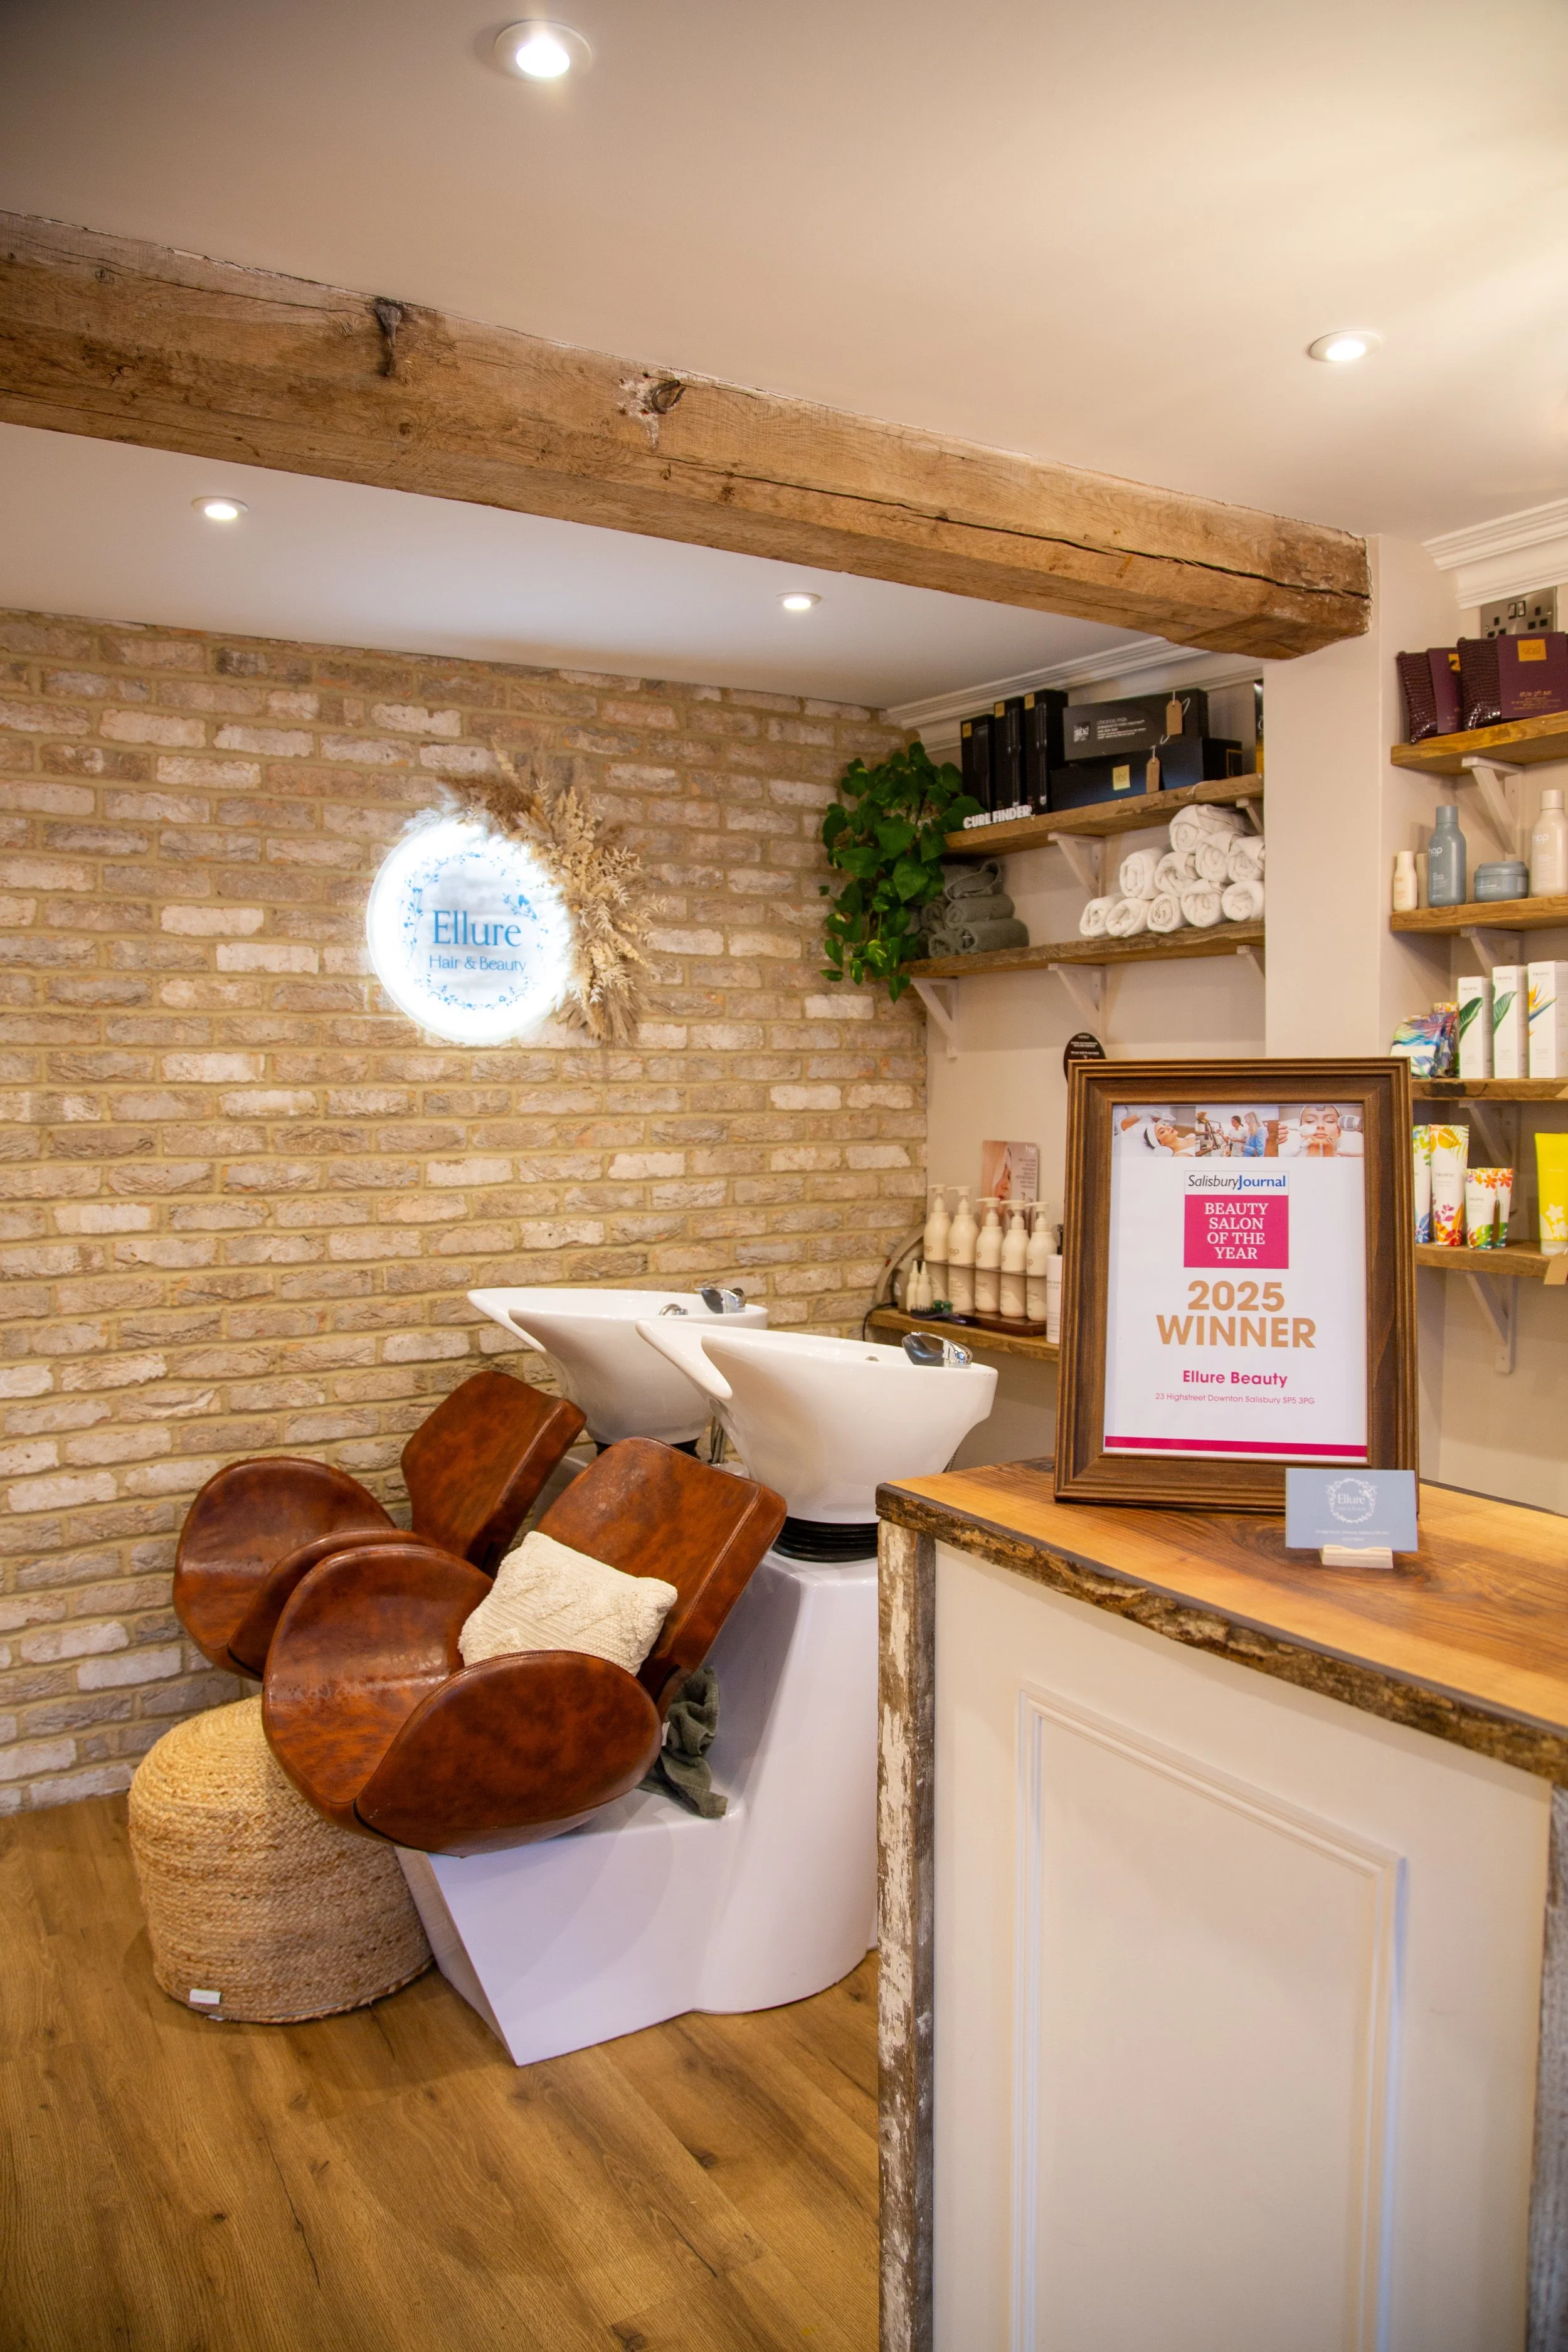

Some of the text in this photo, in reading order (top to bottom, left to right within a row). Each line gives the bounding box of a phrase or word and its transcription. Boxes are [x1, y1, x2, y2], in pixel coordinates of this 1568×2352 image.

[963, 805, 1032, 829] CURL FINDER
[433, 909, 521, 947] Ellure
[430, 954, 526, 974] Hair & Beauty
[1204, 1202, 1269, 1215] BEAUTY
[1209, 1217, 1264, 1230] SALON
[1207, 1232, 1266, 1245] OF THE
[1214, 1247, 1258, 1259] YEAR
[1188, 1279, 1285, 1312] 2025
[1156, 1315, 1316, 1348] WINNER
[1183, 1370, 1288, 1388] Ellure Beauty
[1167, 1393, 1205, 1402] Highstreet
[1208, 1394, 1243, 1402] Downton
[1245, 1396, 1281, 1405] Salisbury
[1283, 1396, 1297, 1404] SP5
[1338, 1493, 1365, 1505] Ellure
